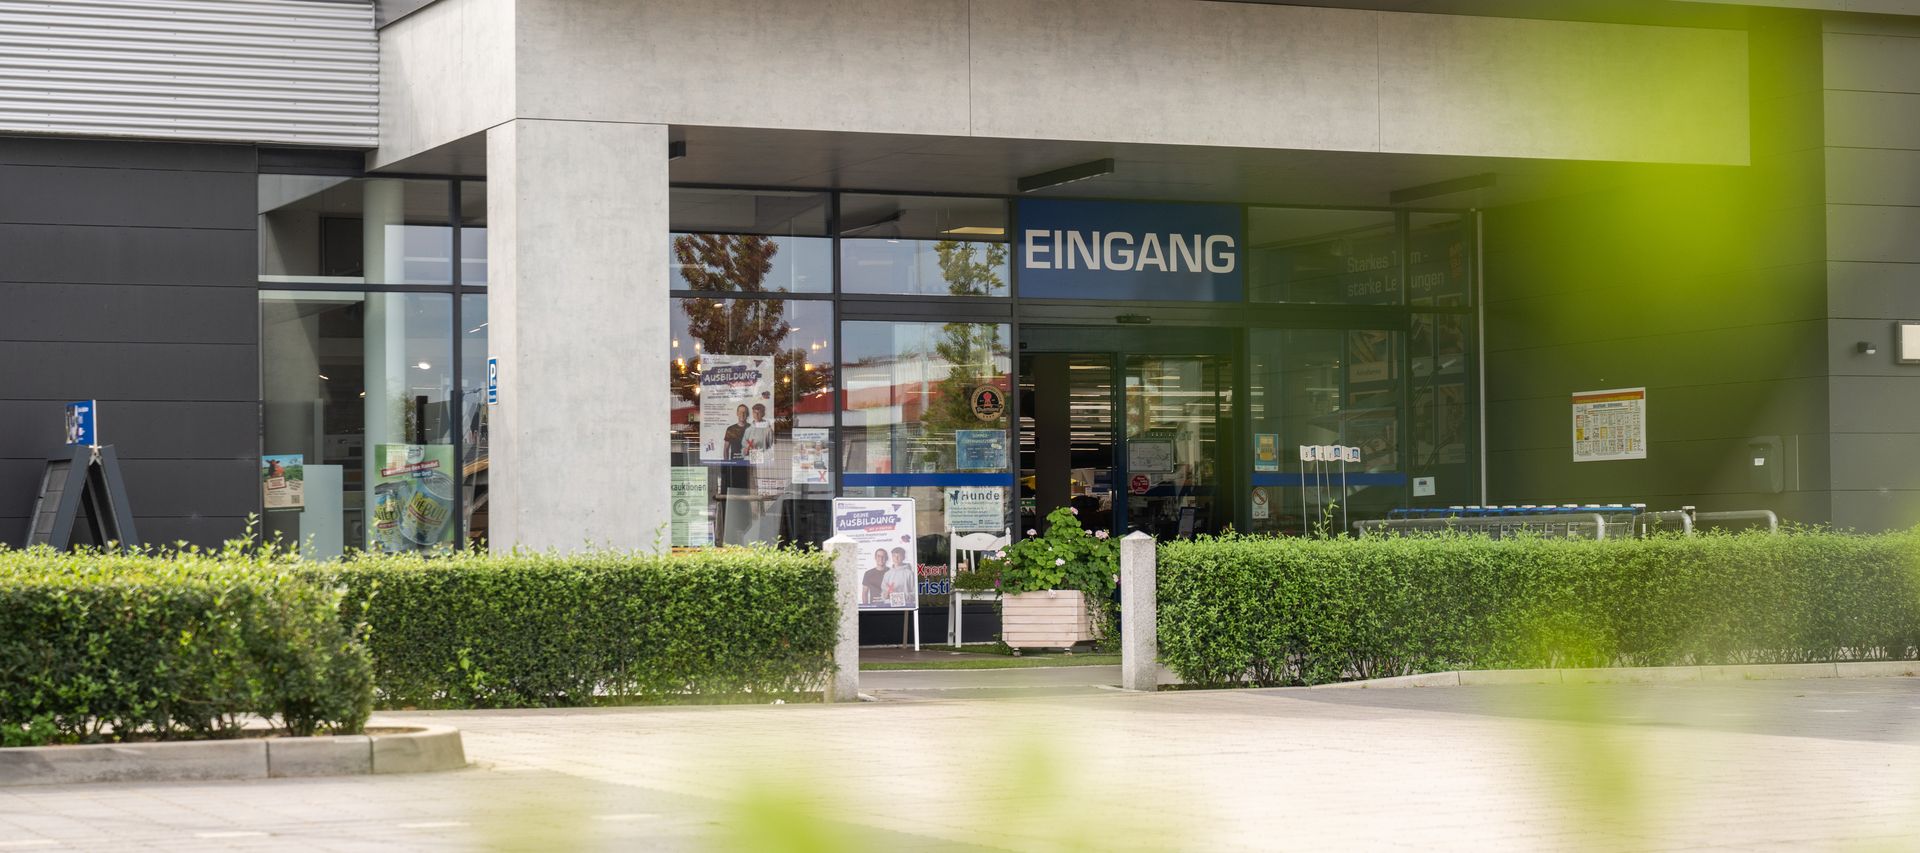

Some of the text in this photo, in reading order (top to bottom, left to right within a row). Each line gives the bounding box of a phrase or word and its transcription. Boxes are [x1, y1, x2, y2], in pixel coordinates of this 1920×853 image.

[1025, 229, 1236, 274] EINGANG
[1347, 255, 1389, 273] Starkes
[1391, 249, 1421, 266] Tm
[1347, 271, 1445, 297] starke Leungen
[704, 371, 757, 383] AUSBILDUNG
[961, 490, 1000, 501] Hunde
[839, 516, 896, 528] AUSBILDUNG
